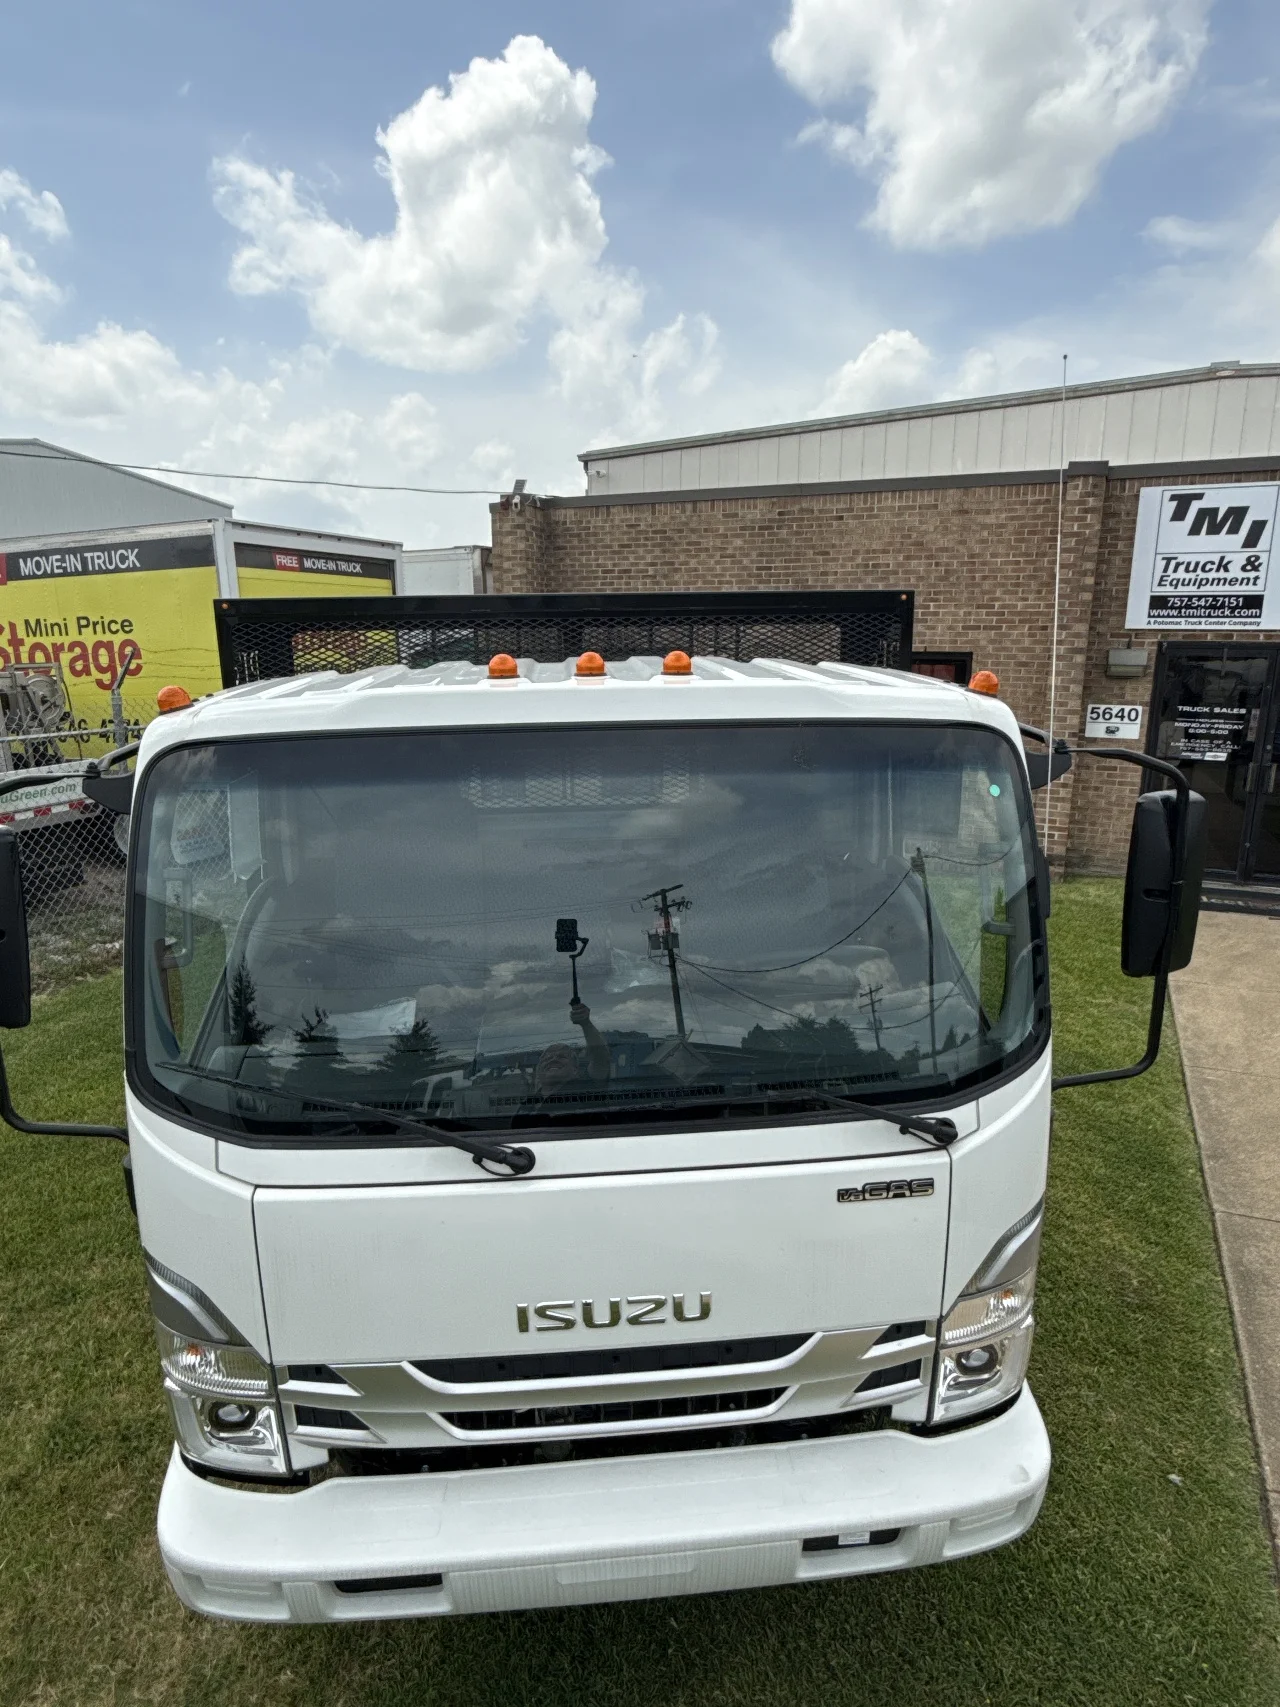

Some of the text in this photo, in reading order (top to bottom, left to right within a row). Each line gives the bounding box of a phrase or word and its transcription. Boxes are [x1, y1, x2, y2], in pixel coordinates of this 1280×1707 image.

[1168, 492, 1269, 549] TMI
[19, 548, 141, 577] MOVE-IN TRUCK
[276, 554, 299, 567] FREE
[303, 557, 362, 574] MOVE-IN TRUCK
[1161, 554, 1263, 574] Truck &
[1157, 574, 1260, 590] Equipment
[1167, 597, 1243, 607] 757-547-7151
[1149, 607, 1260, 617] www.tmitruck.com
[24, 615, 134, 638] Mini Price
[1089, 706, 1139, 722] 5640
[1177, 705, 1210, 713] TRUCK
[862, 1178, 934, 1201] GAS
[516, 1290, 713, 1333] ISUZU
